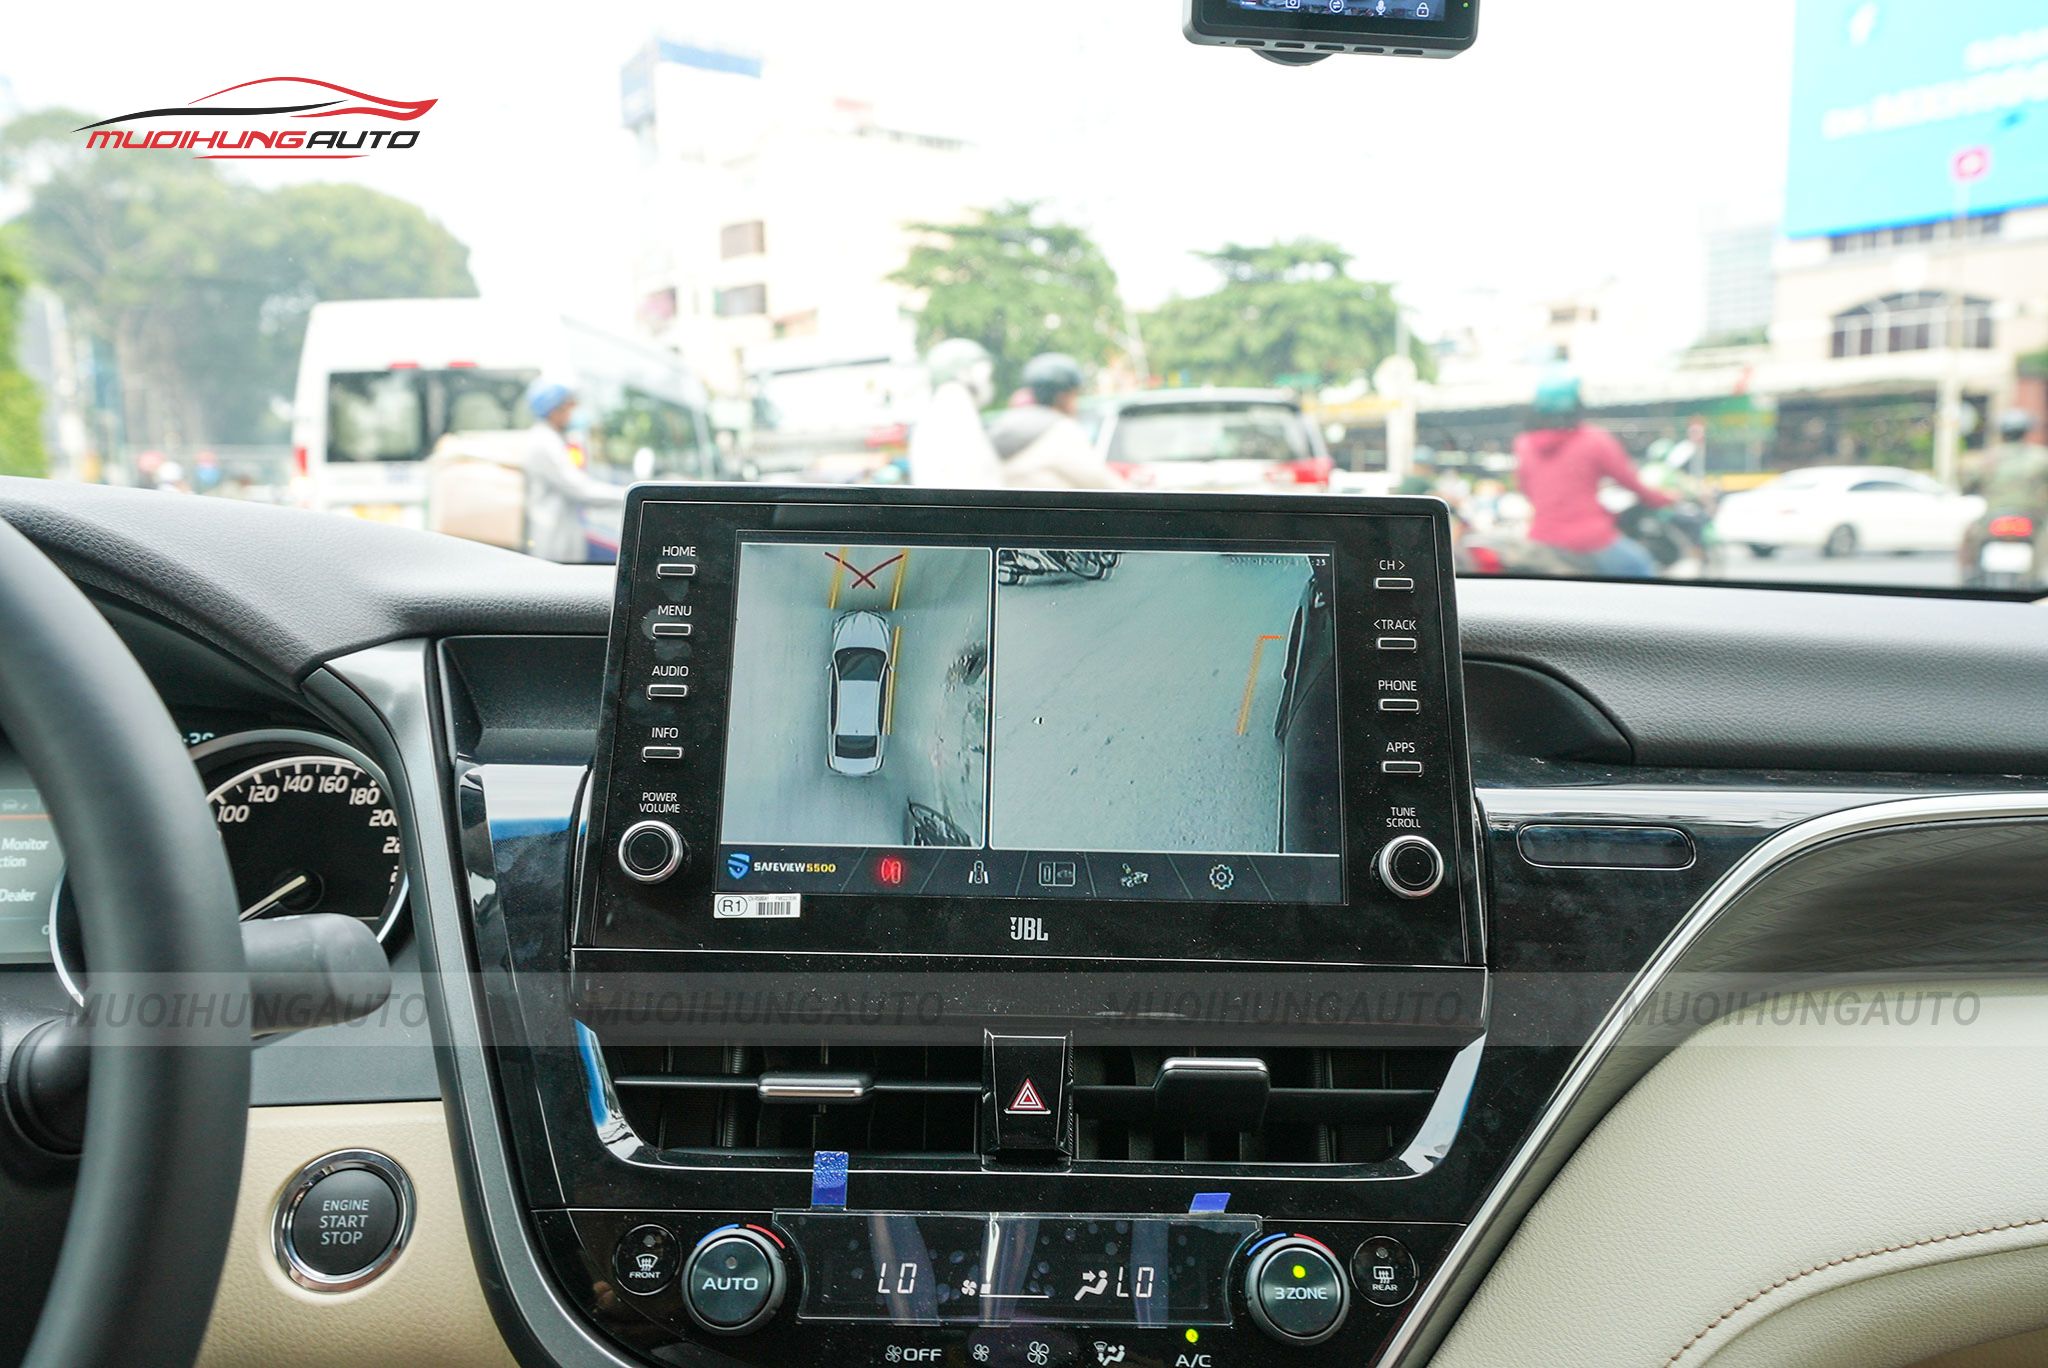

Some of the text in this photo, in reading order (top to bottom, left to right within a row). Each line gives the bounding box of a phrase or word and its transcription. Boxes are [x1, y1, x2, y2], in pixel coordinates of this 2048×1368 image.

[662, 546, 697, 557] HOME
[657, 605, 692, 616] MENU
[651, 665, 689, 677] AUDIO
[1377, 680, 1418, 691] PHONE
[651, 727, 679, 739] INFO
[1386, 742, 1416, 753] APPS
[283, 775, 313, 792] 140
[318, 776, 349, 793] 160
[248, 785, 279, 803] 120
[349, 788, 381, 805] 180
[642, 792, 678, 802] POWER
[217, 805, 250, 823] 100
[639, 803, 680, 814] VOLUME
[1390, 806, 1417, 817] TUNE
[1386, 817, 1422, 828] SCROLL
[1, 838, 49, 850] Monitor
[722, 899, 742, 912] R1
[1010, 916, 1049, 941] JBL
[322, 1199, 370, 1211] ENGINE
[319, 1214, 368, 1229] START
[320, 1231, 363, 1245] STOP
[702, 1277, 758, 1291] AUTO
[878, 1262, 917, 1294] LO
[1116, 1266, 1155, 1298] LO
[1372, 1284, 1398, 1292] REAR
[903, 1348, 942, 1362] OFF
[1175, 1354, 1212, 1368] A/C
